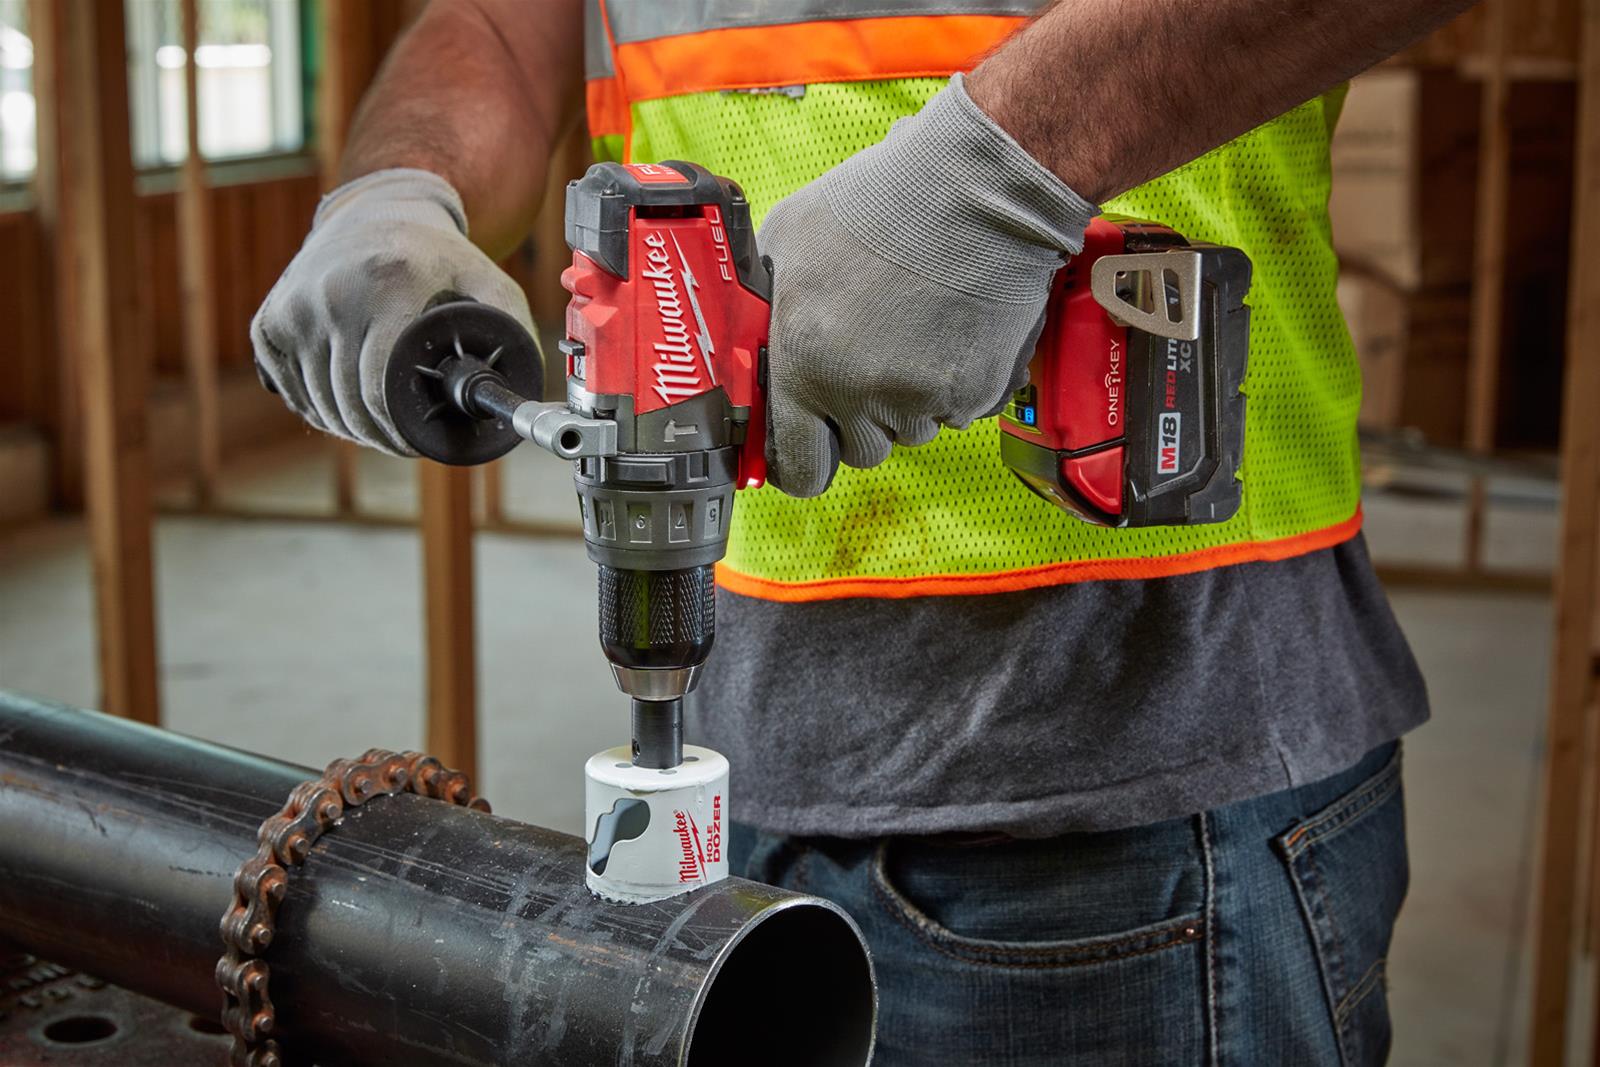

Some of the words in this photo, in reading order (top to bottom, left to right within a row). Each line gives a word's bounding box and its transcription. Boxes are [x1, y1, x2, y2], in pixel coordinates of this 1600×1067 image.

[710, 207, 733, 282] FUEL
[642, 230, 705, 405] Milwaukee
[1180, 342, 1192, 374] XC
[1160, 416, 1177, 470] M18
[674, 512, 685, 530] 7
[708, 507, 717, 523] 5
[672, 810, 702, 883] Milwaukee
[713, 795, 721, 863] DOZER
